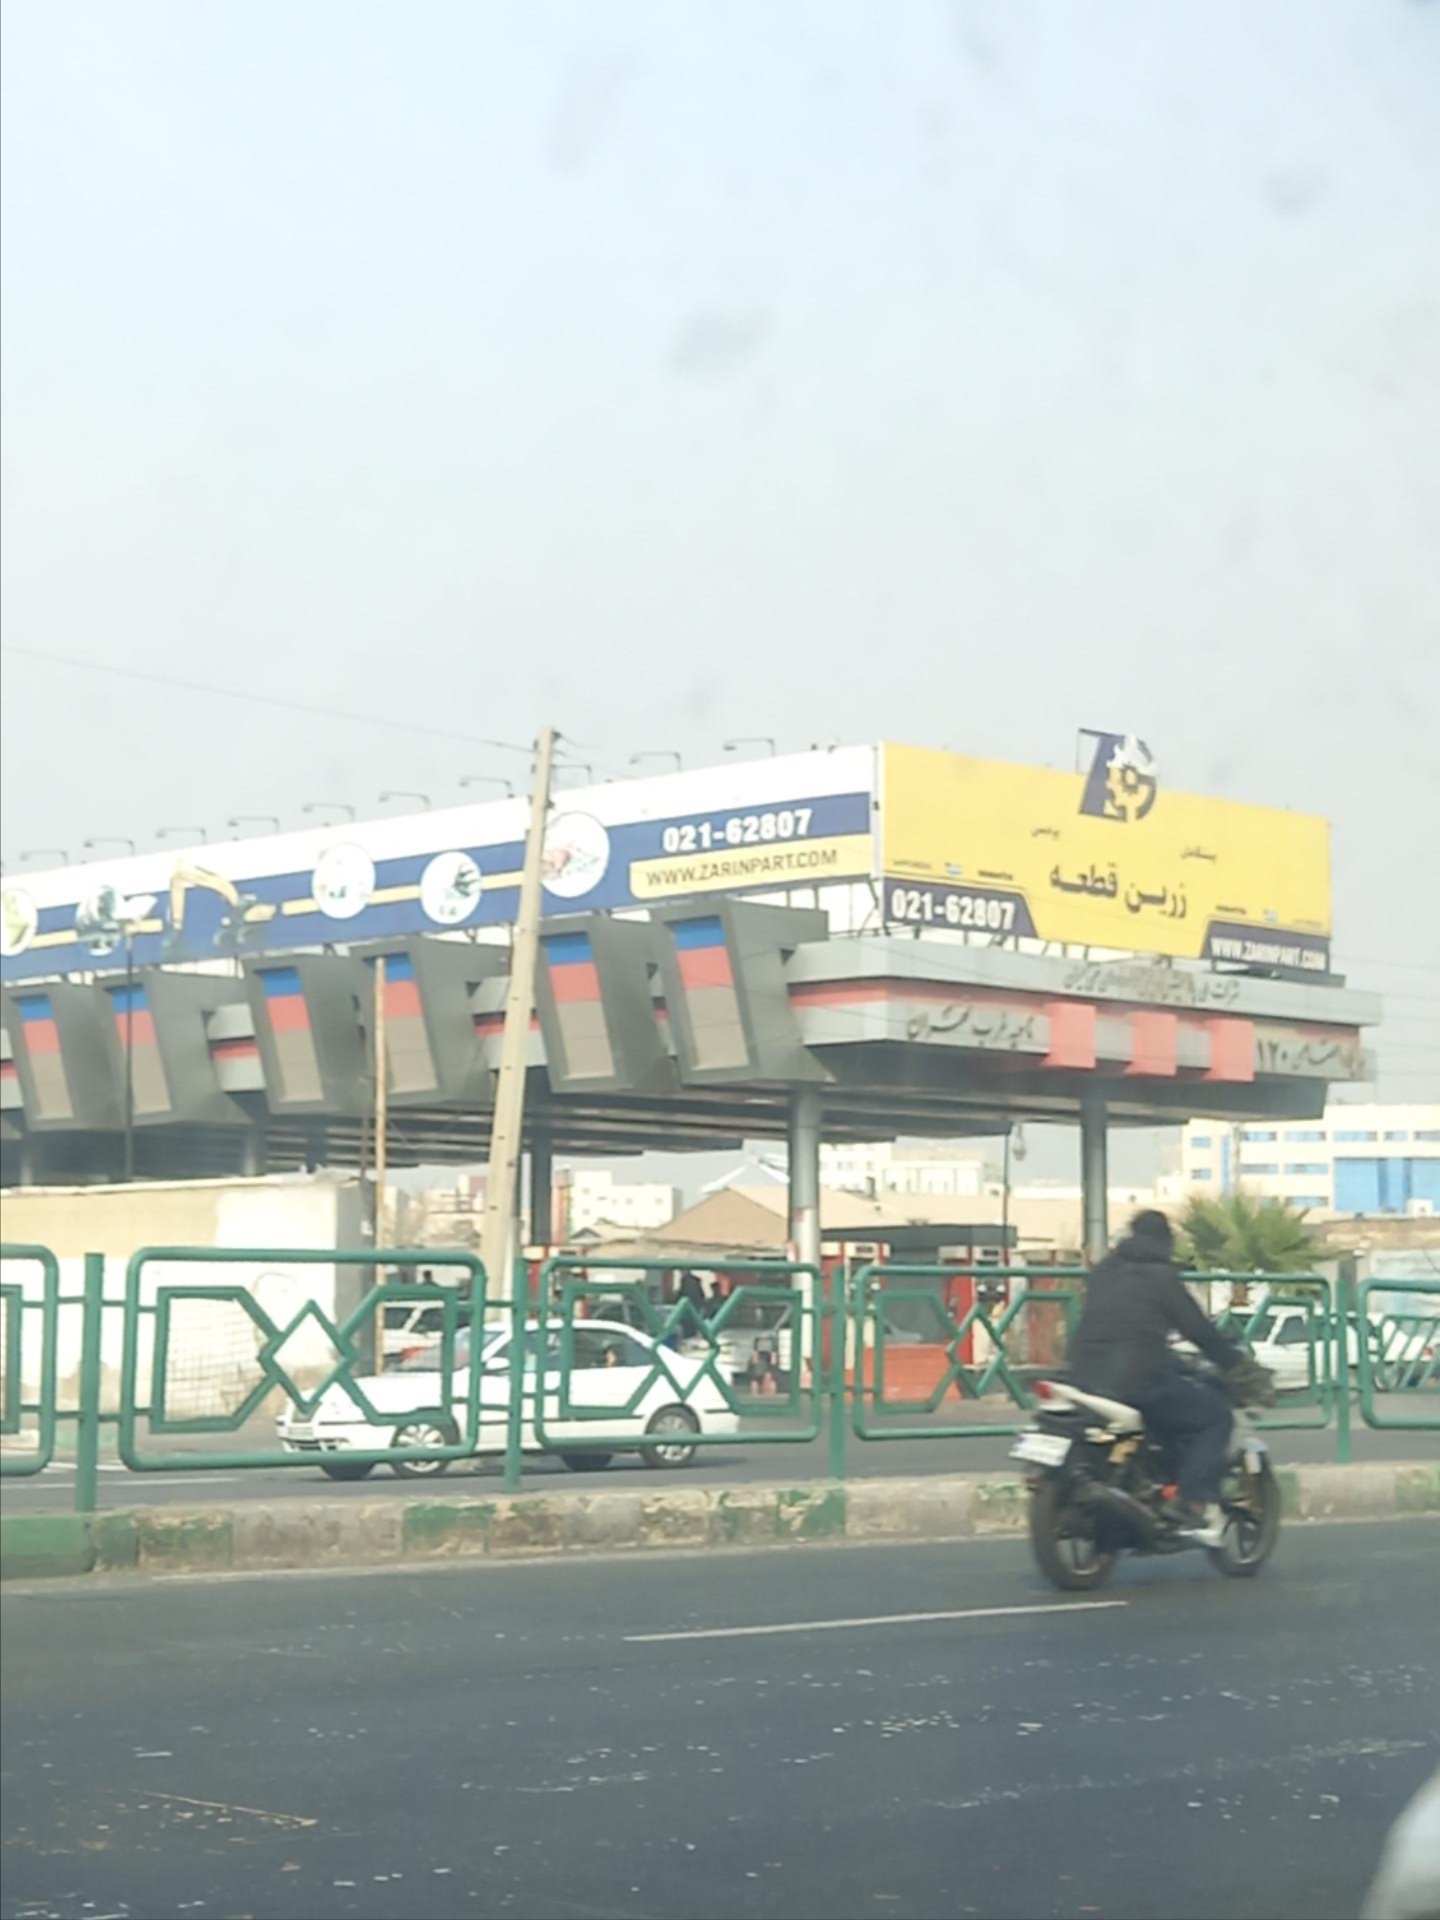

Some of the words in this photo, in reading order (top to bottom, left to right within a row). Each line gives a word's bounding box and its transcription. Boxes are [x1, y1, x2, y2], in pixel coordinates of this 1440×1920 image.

[662, 808, 813, 853] 021-62807
[646, 849, 839, 887] WWW.ZARINPART.COM
[1049, 861, 1119, 899] قطعه
[891, 887, 1016, 930] 021-62807
[1124, 880, 1188, 919] زرین
